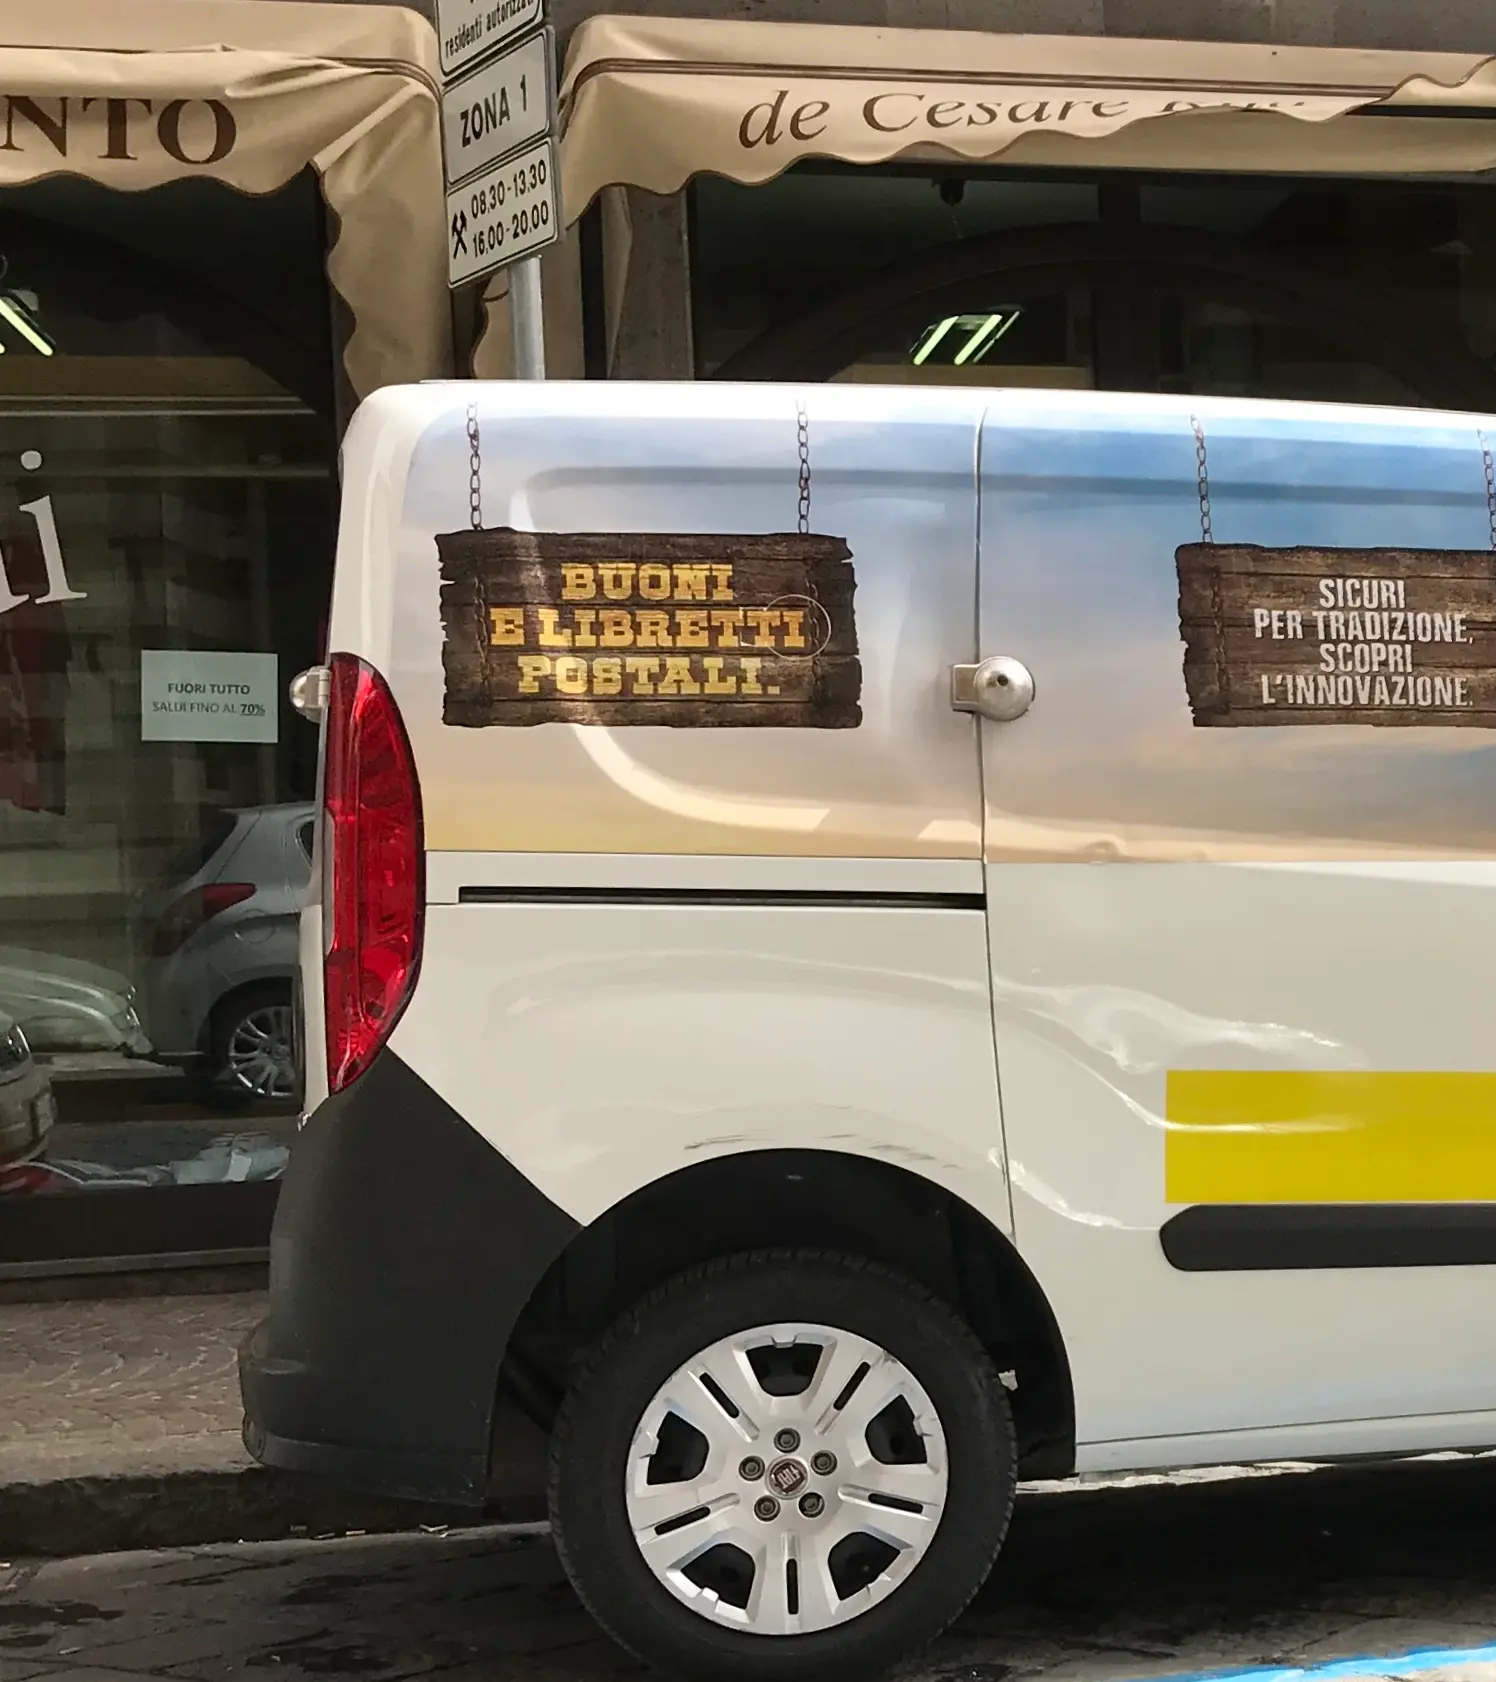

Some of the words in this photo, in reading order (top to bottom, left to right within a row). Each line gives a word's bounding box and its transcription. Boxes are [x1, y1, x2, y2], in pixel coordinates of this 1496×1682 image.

[445, 13, 482, 59] residenti
[460, 86, 511, 148] ZONA
[520, 74, 527, 112] 1
[738, 90, 830, 148] de
[862, 92, 1130, 132] Cesare
[561, 563, 733, 601] BUONI
[1319, 579, 1406, 608] SICURI
[490, 607, 525, 646] E
[536, 607, 805, 648] LIBRETTI
[1254, 608, 1303, 640] PER
[1312, 611, 1475, 645] TRADIZIONE,
[518, 655, 781, 695] POSTALI.
[1320, 643, 1413, 673] SCOPRI
[168, 683, 206, 693] FUORI
[209, 684, 250, 694] TUTTO
[190, 702, 220, 713] FINO
[222, 703, 237, 713] AL
[240, 703, 266, 716] 70%
